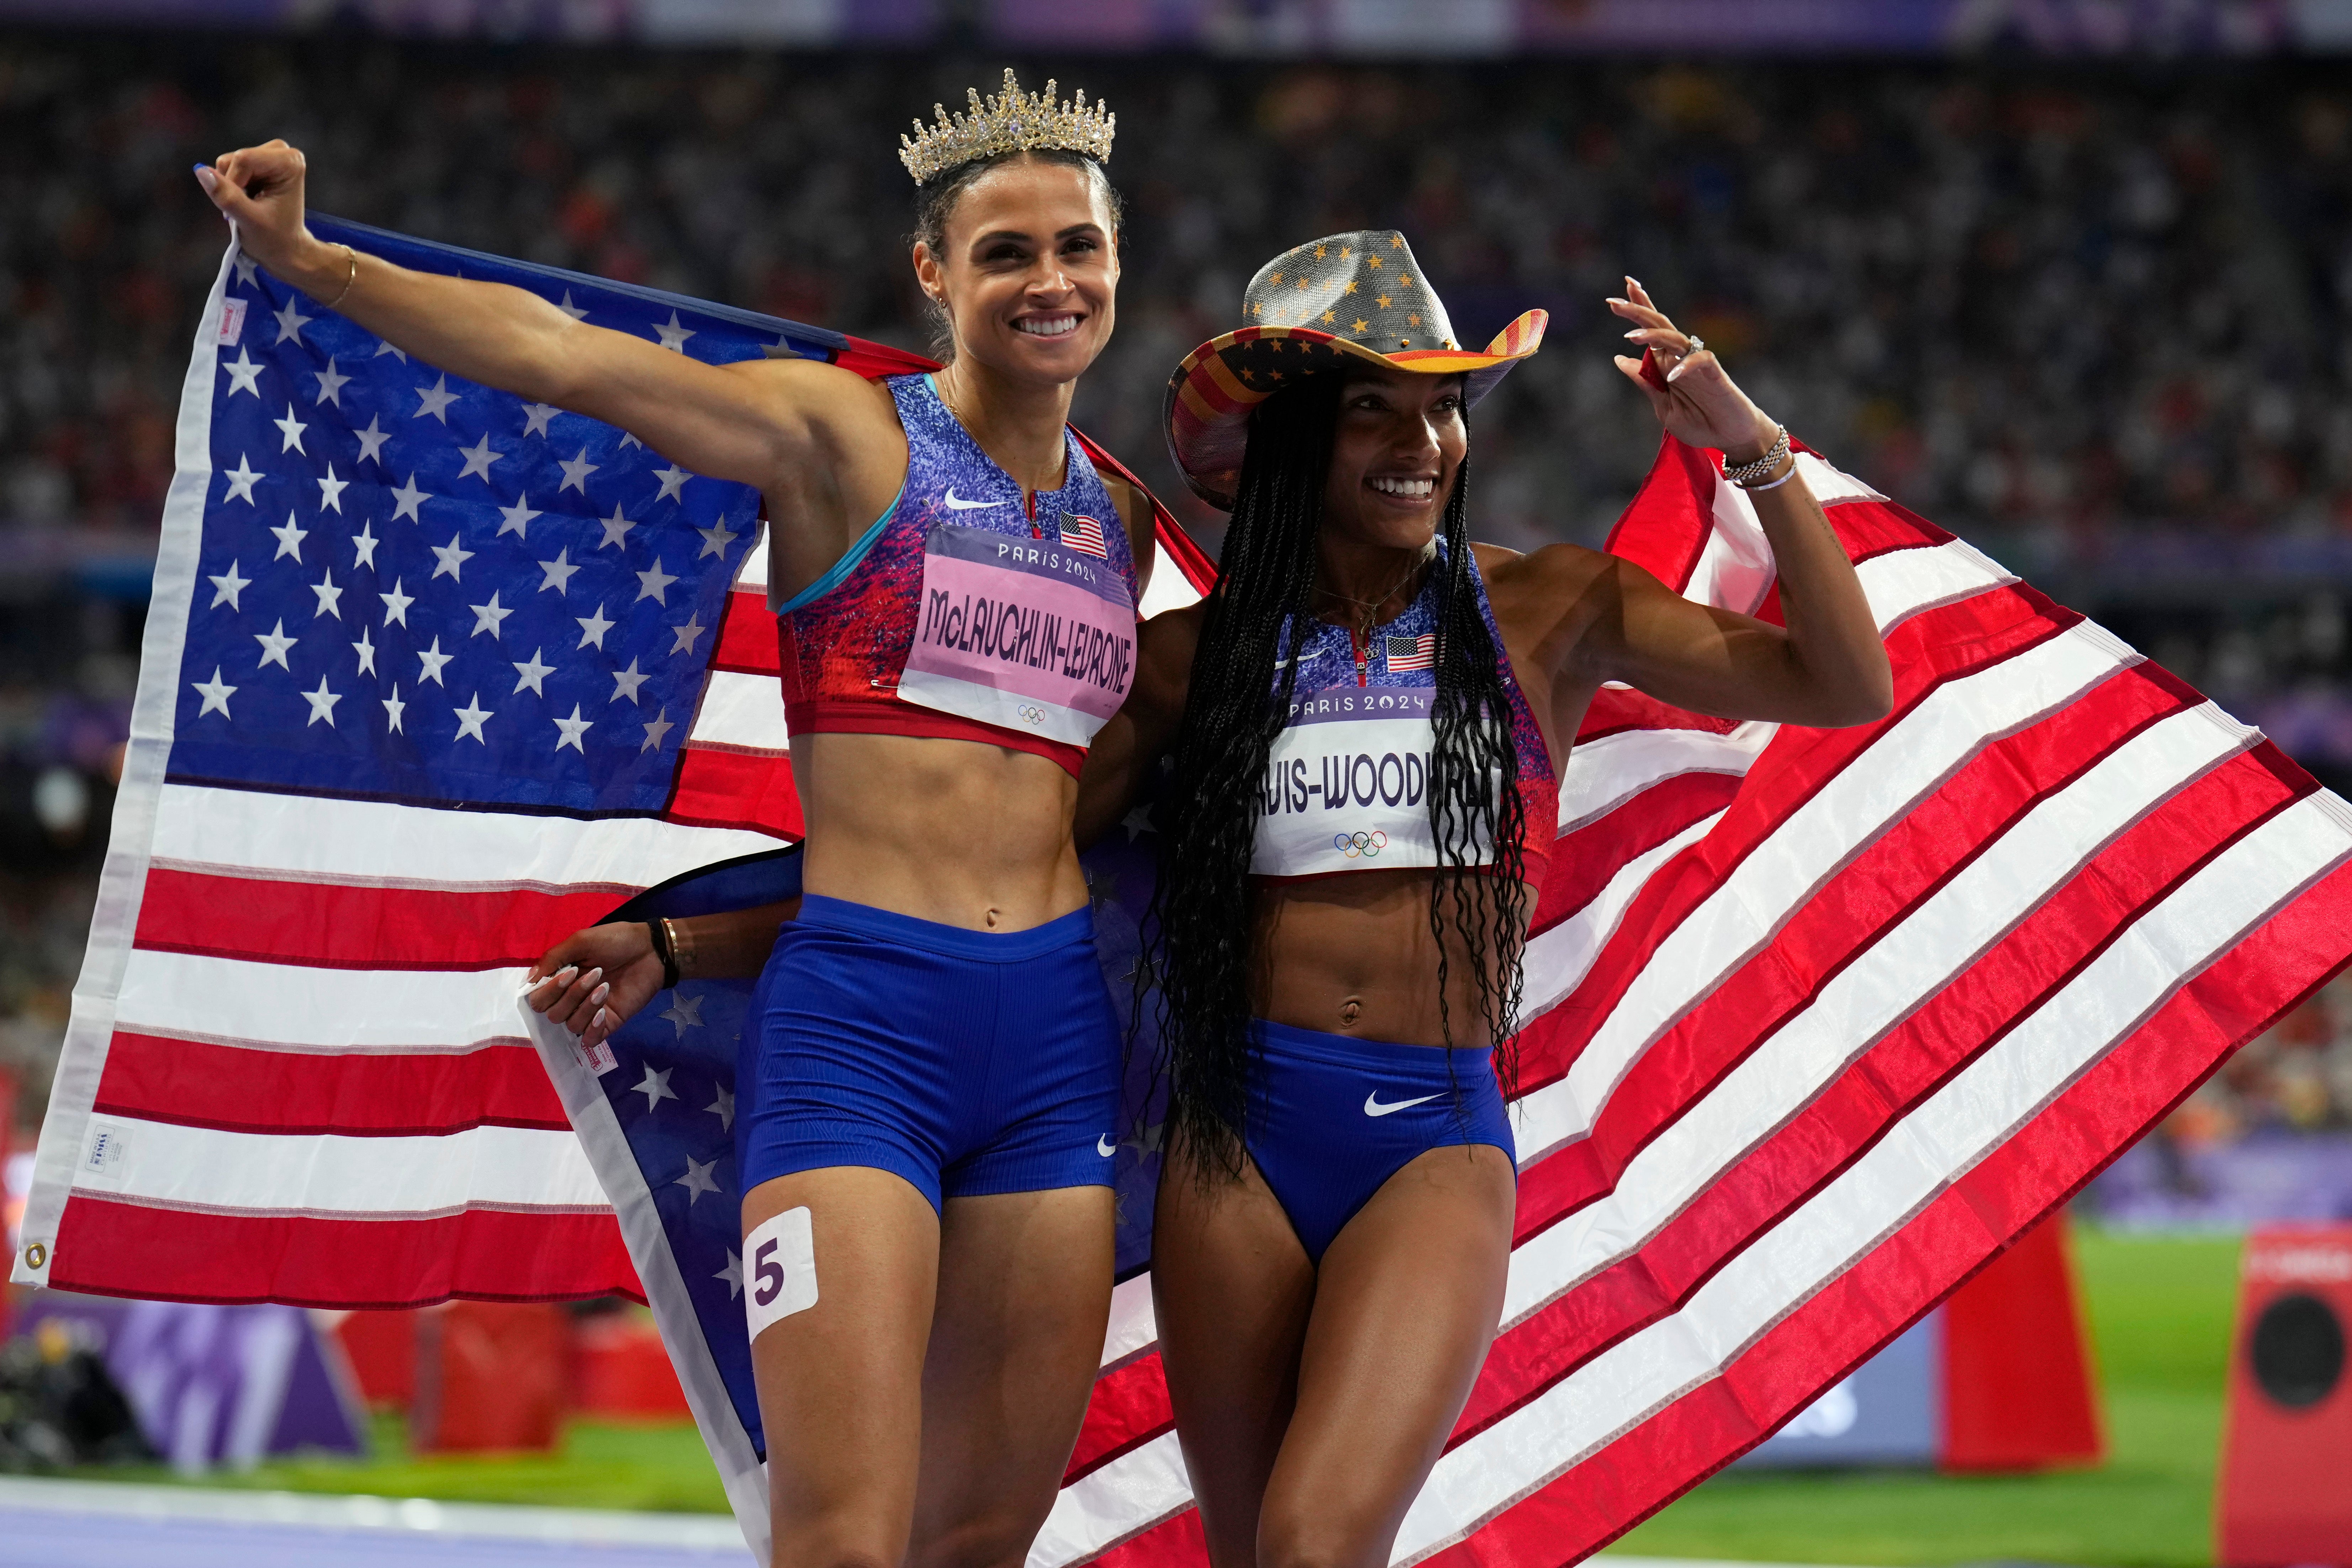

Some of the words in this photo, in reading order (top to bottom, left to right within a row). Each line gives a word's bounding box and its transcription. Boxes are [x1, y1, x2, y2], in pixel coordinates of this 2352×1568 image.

[1065, 558, 1096, 584] 2024
[923, 588, 1131, 694] McLAUGHLIN-LEVRONE
[1364, 695, 1424, 710] 2024
[754, 1237, 784, 1306] 5
